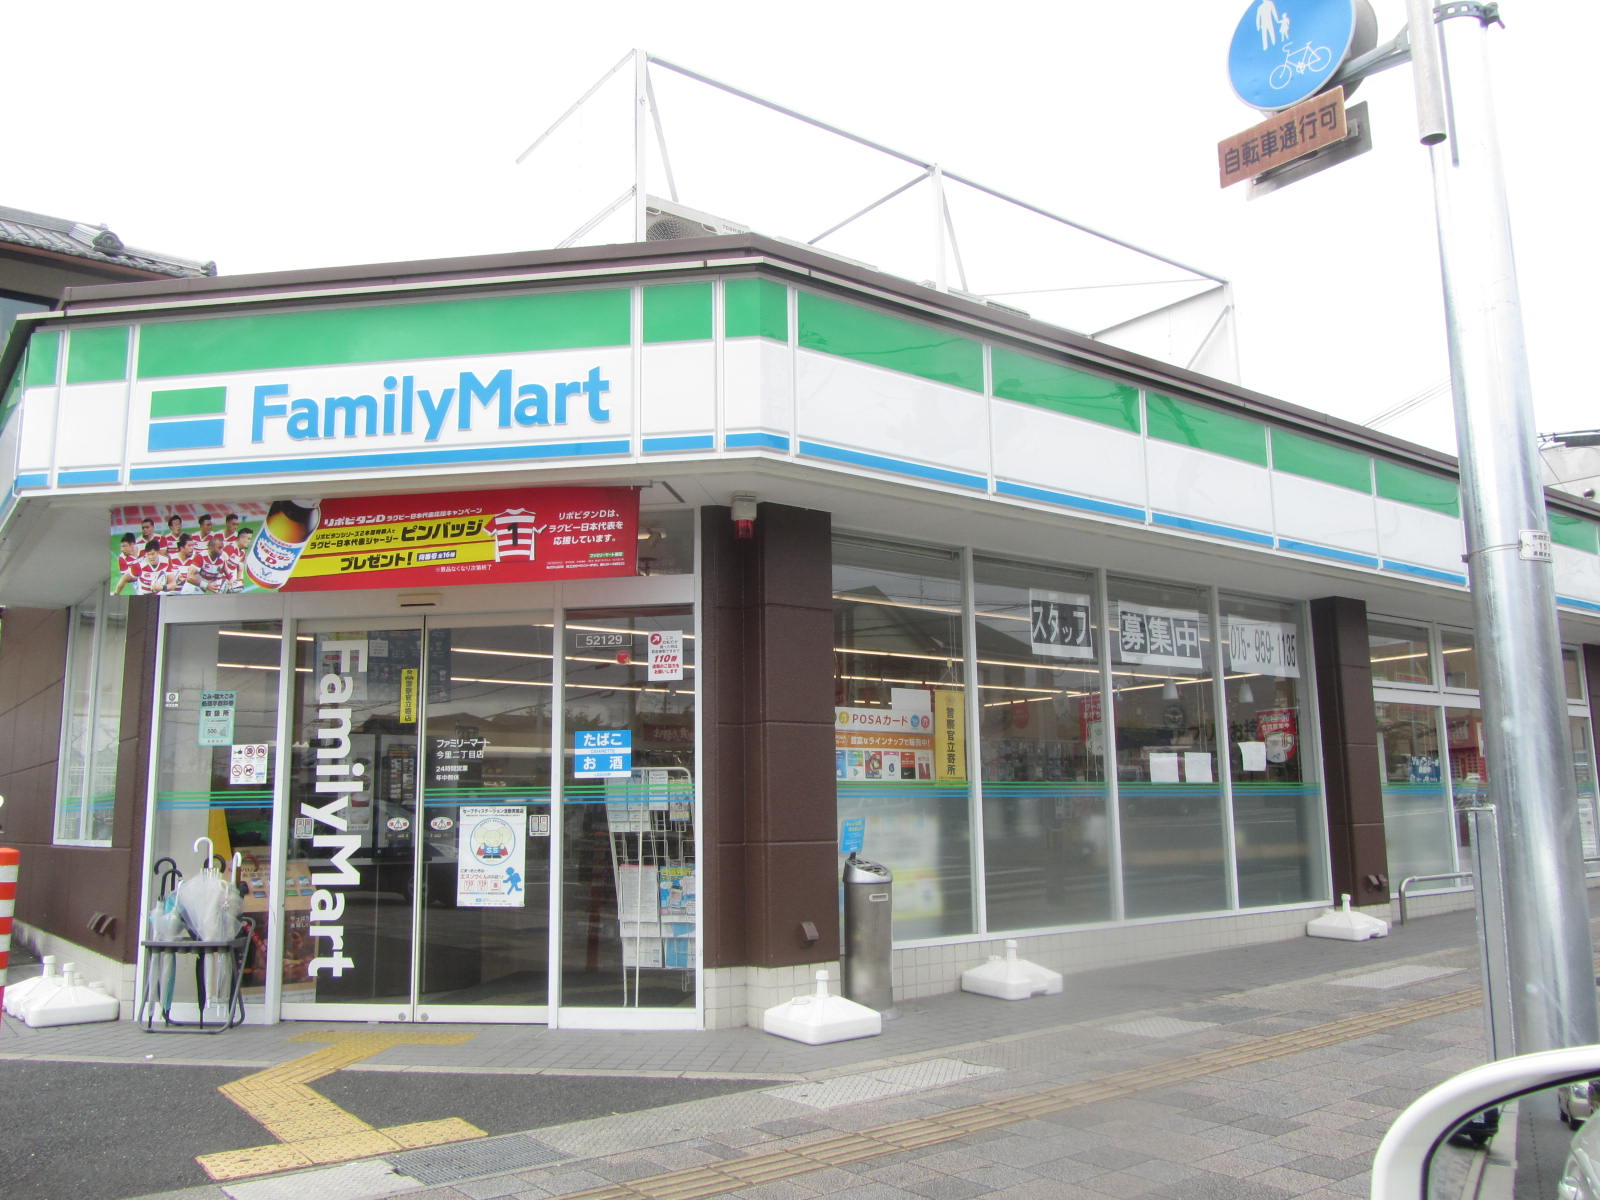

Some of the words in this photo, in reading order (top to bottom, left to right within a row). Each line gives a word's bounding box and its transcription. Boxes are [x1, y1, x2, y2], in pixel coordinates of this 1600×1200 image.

[1224, 102, 1338, 175] 自転車通行可
[251, 366, 610, 442] FamilyMart
[324, 513, 385, 527] リポビタンD
[558, 509, 620, 520] リポビタンDは、
[401, 519, 483, 541] ピンバッジ
[548, 520, 624, 533] ラグビー日本代表を
[506, 523, 519, 546] 1
[552, 533, 616, 546] 応援しています。
[310, 535, 398, 550] ラグビー日本代表ジャージー
[1032, 604, 1087, 645] スタッフ
[585, 634, 623, 646] 52129
[1121, 613, 1198, 657] 募集中
[654, 654, 678, 663] 110番
[852, 713, 909, 726] POSAカード
[436, 737, 491, 748] ファミリーマート
[583, 733, 622, 747] たばこ
[946, 707, 956, 776] 警察官立寄所
[436, 750, 484, 760] 今里二丁目店
[436, 764, 468, 773] 24時間営業
[583, 755, 623, 770] お酒
[301, 639, 368, 977] FamilyMart
